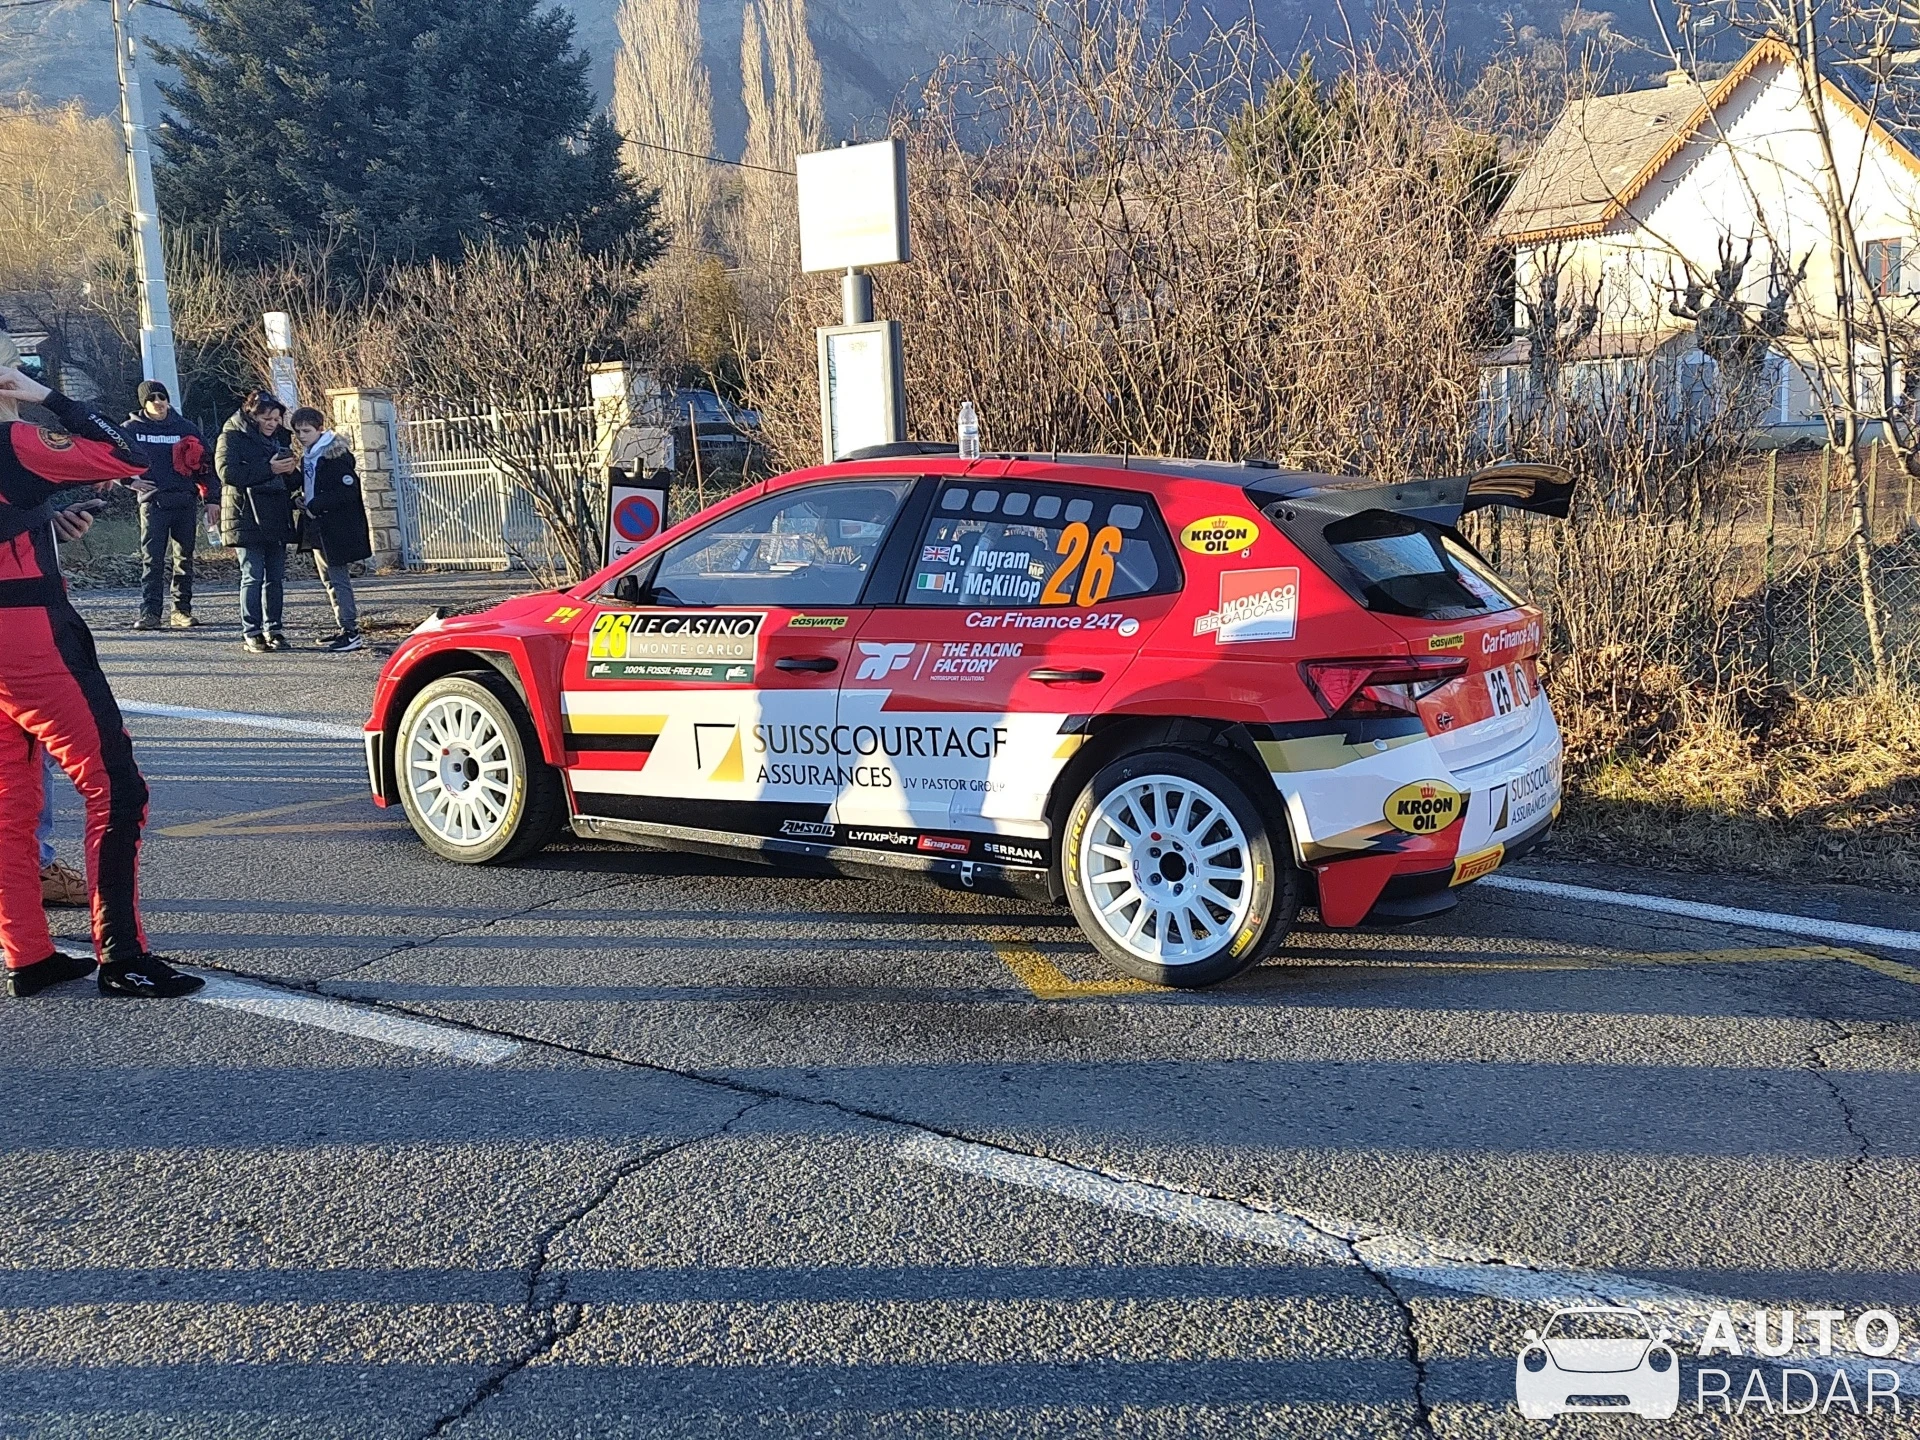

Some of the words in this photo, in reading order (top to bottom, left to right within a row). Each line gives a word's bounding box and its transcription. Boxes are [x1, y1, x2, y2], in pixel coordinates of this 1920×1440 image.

[1191, 528, 1247, 541] KROON
[1205, 541, 1229, 551] OIL
[949, 544, 965, 566] C.
[970, 546, 1030, 572] Ingram
[1039, 522, 1122, 607] 26
[942, 572, 959, 593] H.
[965, 573, 1040, 603] McKillop
[1222, 584, 1296, 615] MONACO
[791, 617, 845, 627] easywrite
[965, 612, 1002, 627] Car
[1002, 612, 1082, 628] Finance
[1083, 613, 1123, 630] 247
[1199, 597, 1294, 631] BROADCAST
[591, 613, 632, 658] 26
[942, 642, 970, 657] THE
[970, 642, 1023, 658] RACING
[624, 666, 645, 674] 100%
[646, 667, 693, 676] FOSSIL-FREE
[693, 668, 712, 676] FUEL
[932, 658, 999, 673] FACTORY
[1490, 670, 1511, 715] 26
[756, 763, 892, 788] ASSURANCES
[903, 777, 917, 789] JV
[922, 778, 967, 791] PASTOR
[969, 779, 1005, 793] GROUP
[1397, 797, 1452, 815] KROON
[779, 820, 836, 837] AMSOIL
[1413, 815, 1437, 830] OIL
[984, 842, 1043, 860] SERRANA
[1456, 849, 1501, 881] PIRELLI
